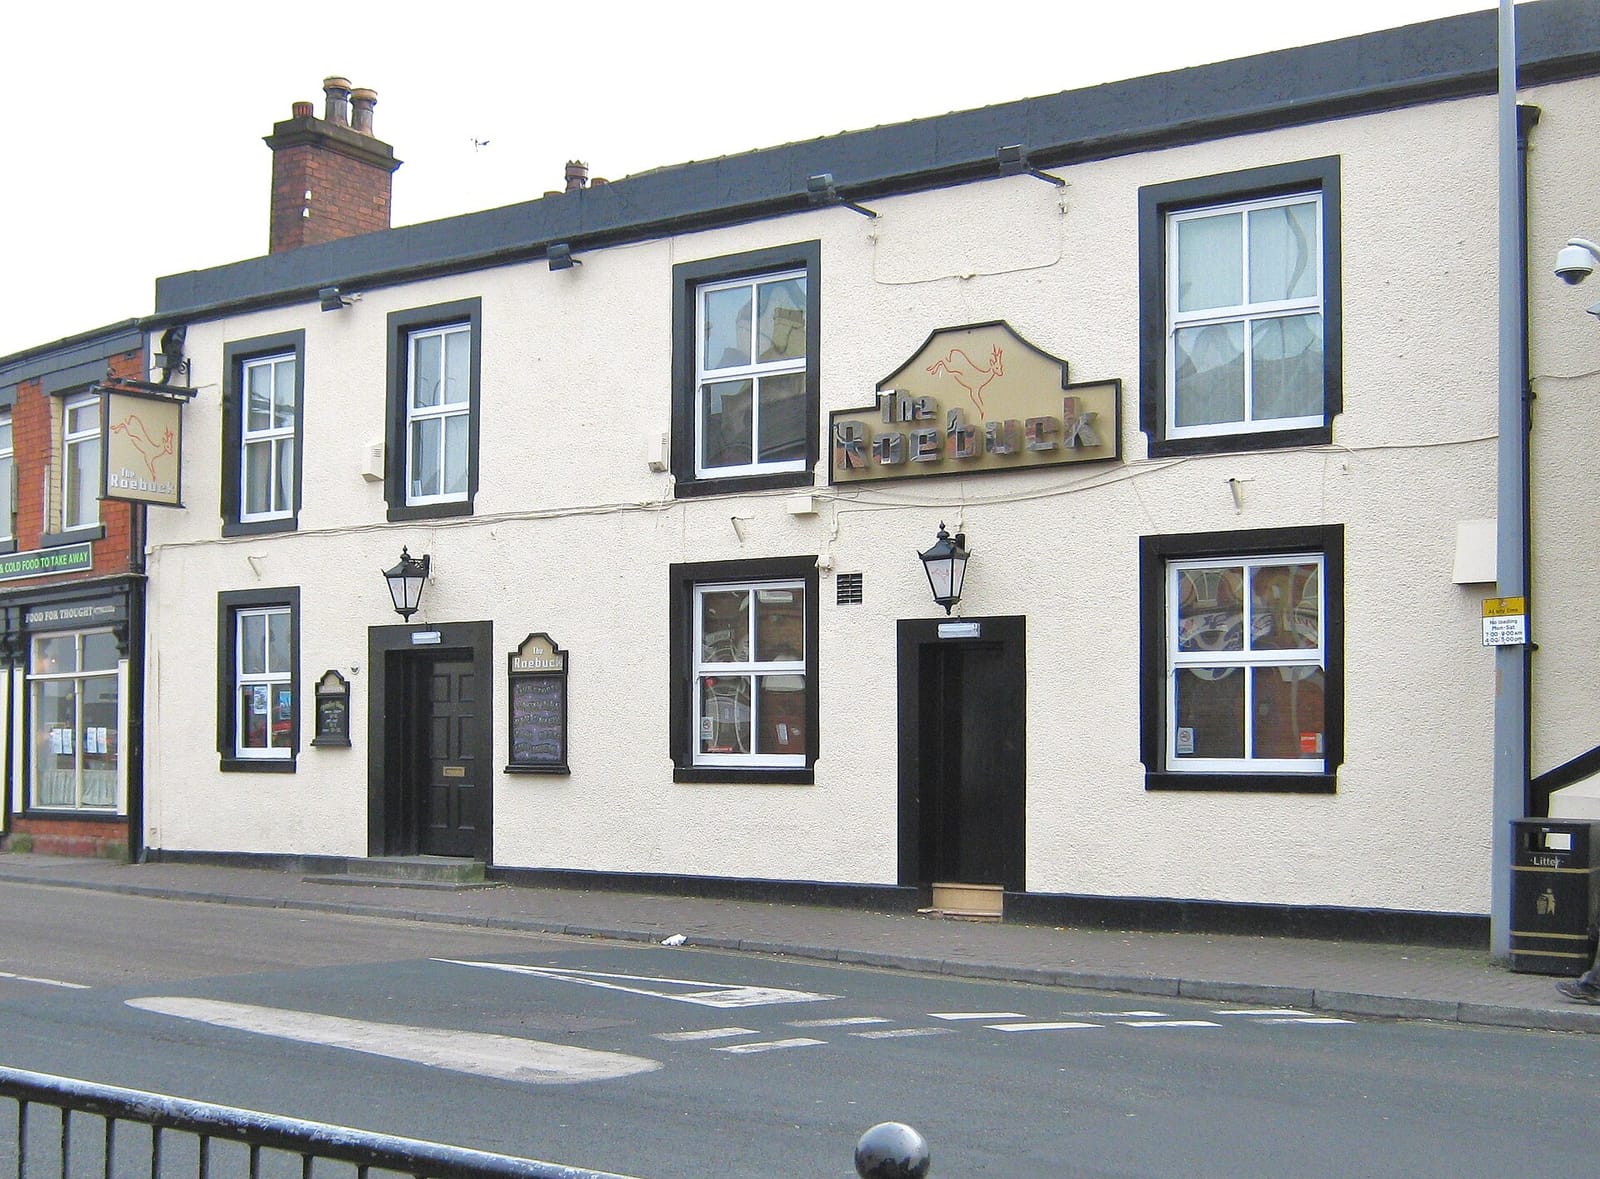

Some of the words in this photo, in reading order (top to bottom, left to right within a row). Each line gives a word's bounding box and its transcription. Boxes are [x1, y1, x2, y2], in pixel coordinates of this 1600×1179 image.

[877, 389, 939, 424] The
[833, 397, 1102, 472] Roebuck
[121, 467, 136, 478] The
[111, 474, 175, 494] Roebuck
[4, 561, 21, 573] COLD
[22, 559, 40, 571] FOOD
[40, 557, 50, 568] TO
[51, 554, 68, 567] TAKE
[68, 552, 88, 564] AWAY
[25, 612, 44, 623] FOOD
[45, 610, 59, 621] FOR
[60, 607, 93, 618] THOUGHT
[1533, 855, 1559, 866] Litter
